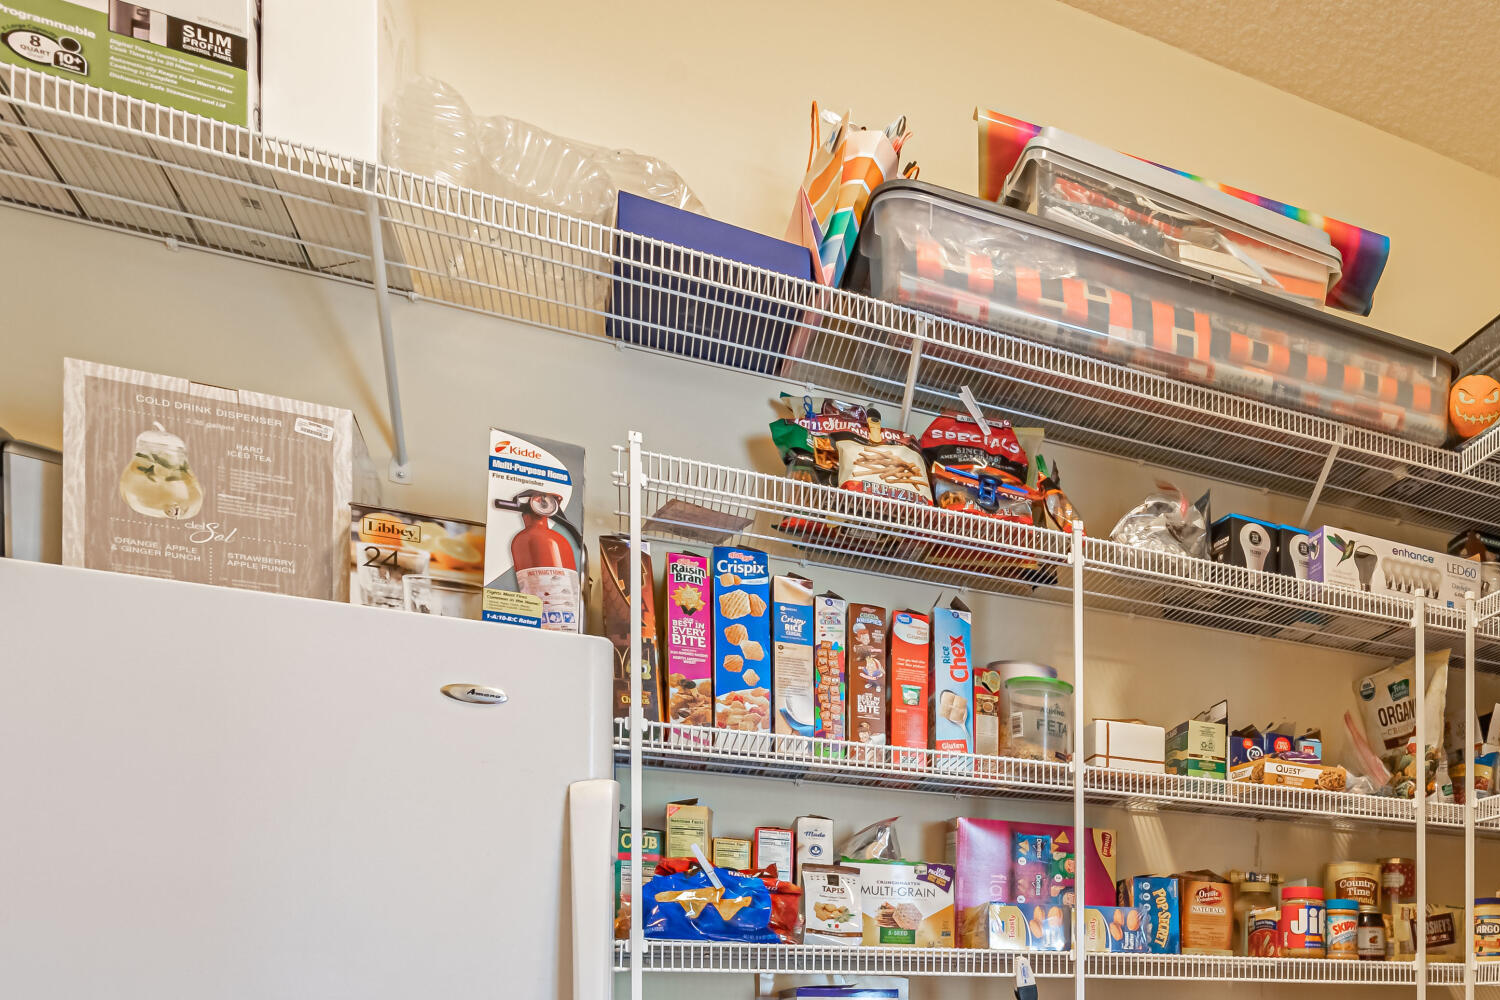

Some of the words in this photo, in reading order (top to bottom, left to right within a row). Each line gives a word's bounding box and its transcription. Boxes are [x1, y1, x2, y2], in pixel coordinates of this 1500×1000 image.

[30, 35, 41, 47] 8
[182, 25, 232, 49] SLIM
[20, 44, 50, 57] QUART
[182, 36, 232, 57] PROFILE
[182, 44, 211, 56] CONTROL
[213, 52, 232, 62] PANEL
[56, 52, 82, 64] 10+
[136, 394, 170, 407] COLD
[174, 401, 212, 414] DRINK
[216, 408, 283, 427] DISPENSER
[931, 429, 1020, 454] SPECIALS
[236, 443, 264, 454] HARD
[509, 445, 542, 460] Kidde
[227, 450, 250, 459] ICED
[253, 455, 272, 463] TEA
[492, 459, 547, 478] Multi-Purpose
[547, 469, 568, 482] Home
[492, 472, 505, 480] Fire
[506, 475, 544, 487] Extinguisher
[184, 521, 205, 531] del
[368, 520, 416, 539] Libbey
[189, 522, 237, 544] Sol
[121, 545, 162, 557] GINGER
[165, 552, 201, 562] PUNCH
[165, 544, 198, 554] APPLE
[1392, 547, 1434, 563] enhance
[362, 546, 402, 568] 24
[227, 560, 259, 571] APPLE
[261, 564, 296, 575] PUNCH
[671, 563, 705, 577] Raisin
[716, 560, 765, 576] Crispix
[1447, 562, 1476, 578] LED60
[675, 573, 702, 585] Bran
[518, 617, 538, 626] Rated
[672, 619, 693, 629] BEST
[695, 622, 705, 630] IN
[780, 615, 806, 626] Crispy
[856, 617, 883, 626] KRISPIES
[672, 627, 706, 637] EVERY
[784, 624, 803, 633] RICE
[672, 634, 707, 648] BITE
[949, 635, 970, 683] Chex
[857, 699, 881, 708] EVERY
[857, 705, 880, 714] BITE
[1378, 698, 1416, 727] ORGAN
[1275, 764, 1301, 776] QUEST
[621, 833, 658, 850] CUB
[822, 885, 845, 894] TAPIS
[1339, 878, 1376, 891] Country
[860, 885, 936, 898] MULTI-GRAIN
[1198, 889, 1218, 898] Orville
[1346, 887, 1371, 896] Time
[1192, 906, 1225, 914] NATURALS
[1290, 907, 1326, 935] Jif
[1476, 925, 1500, 934] ARGO
